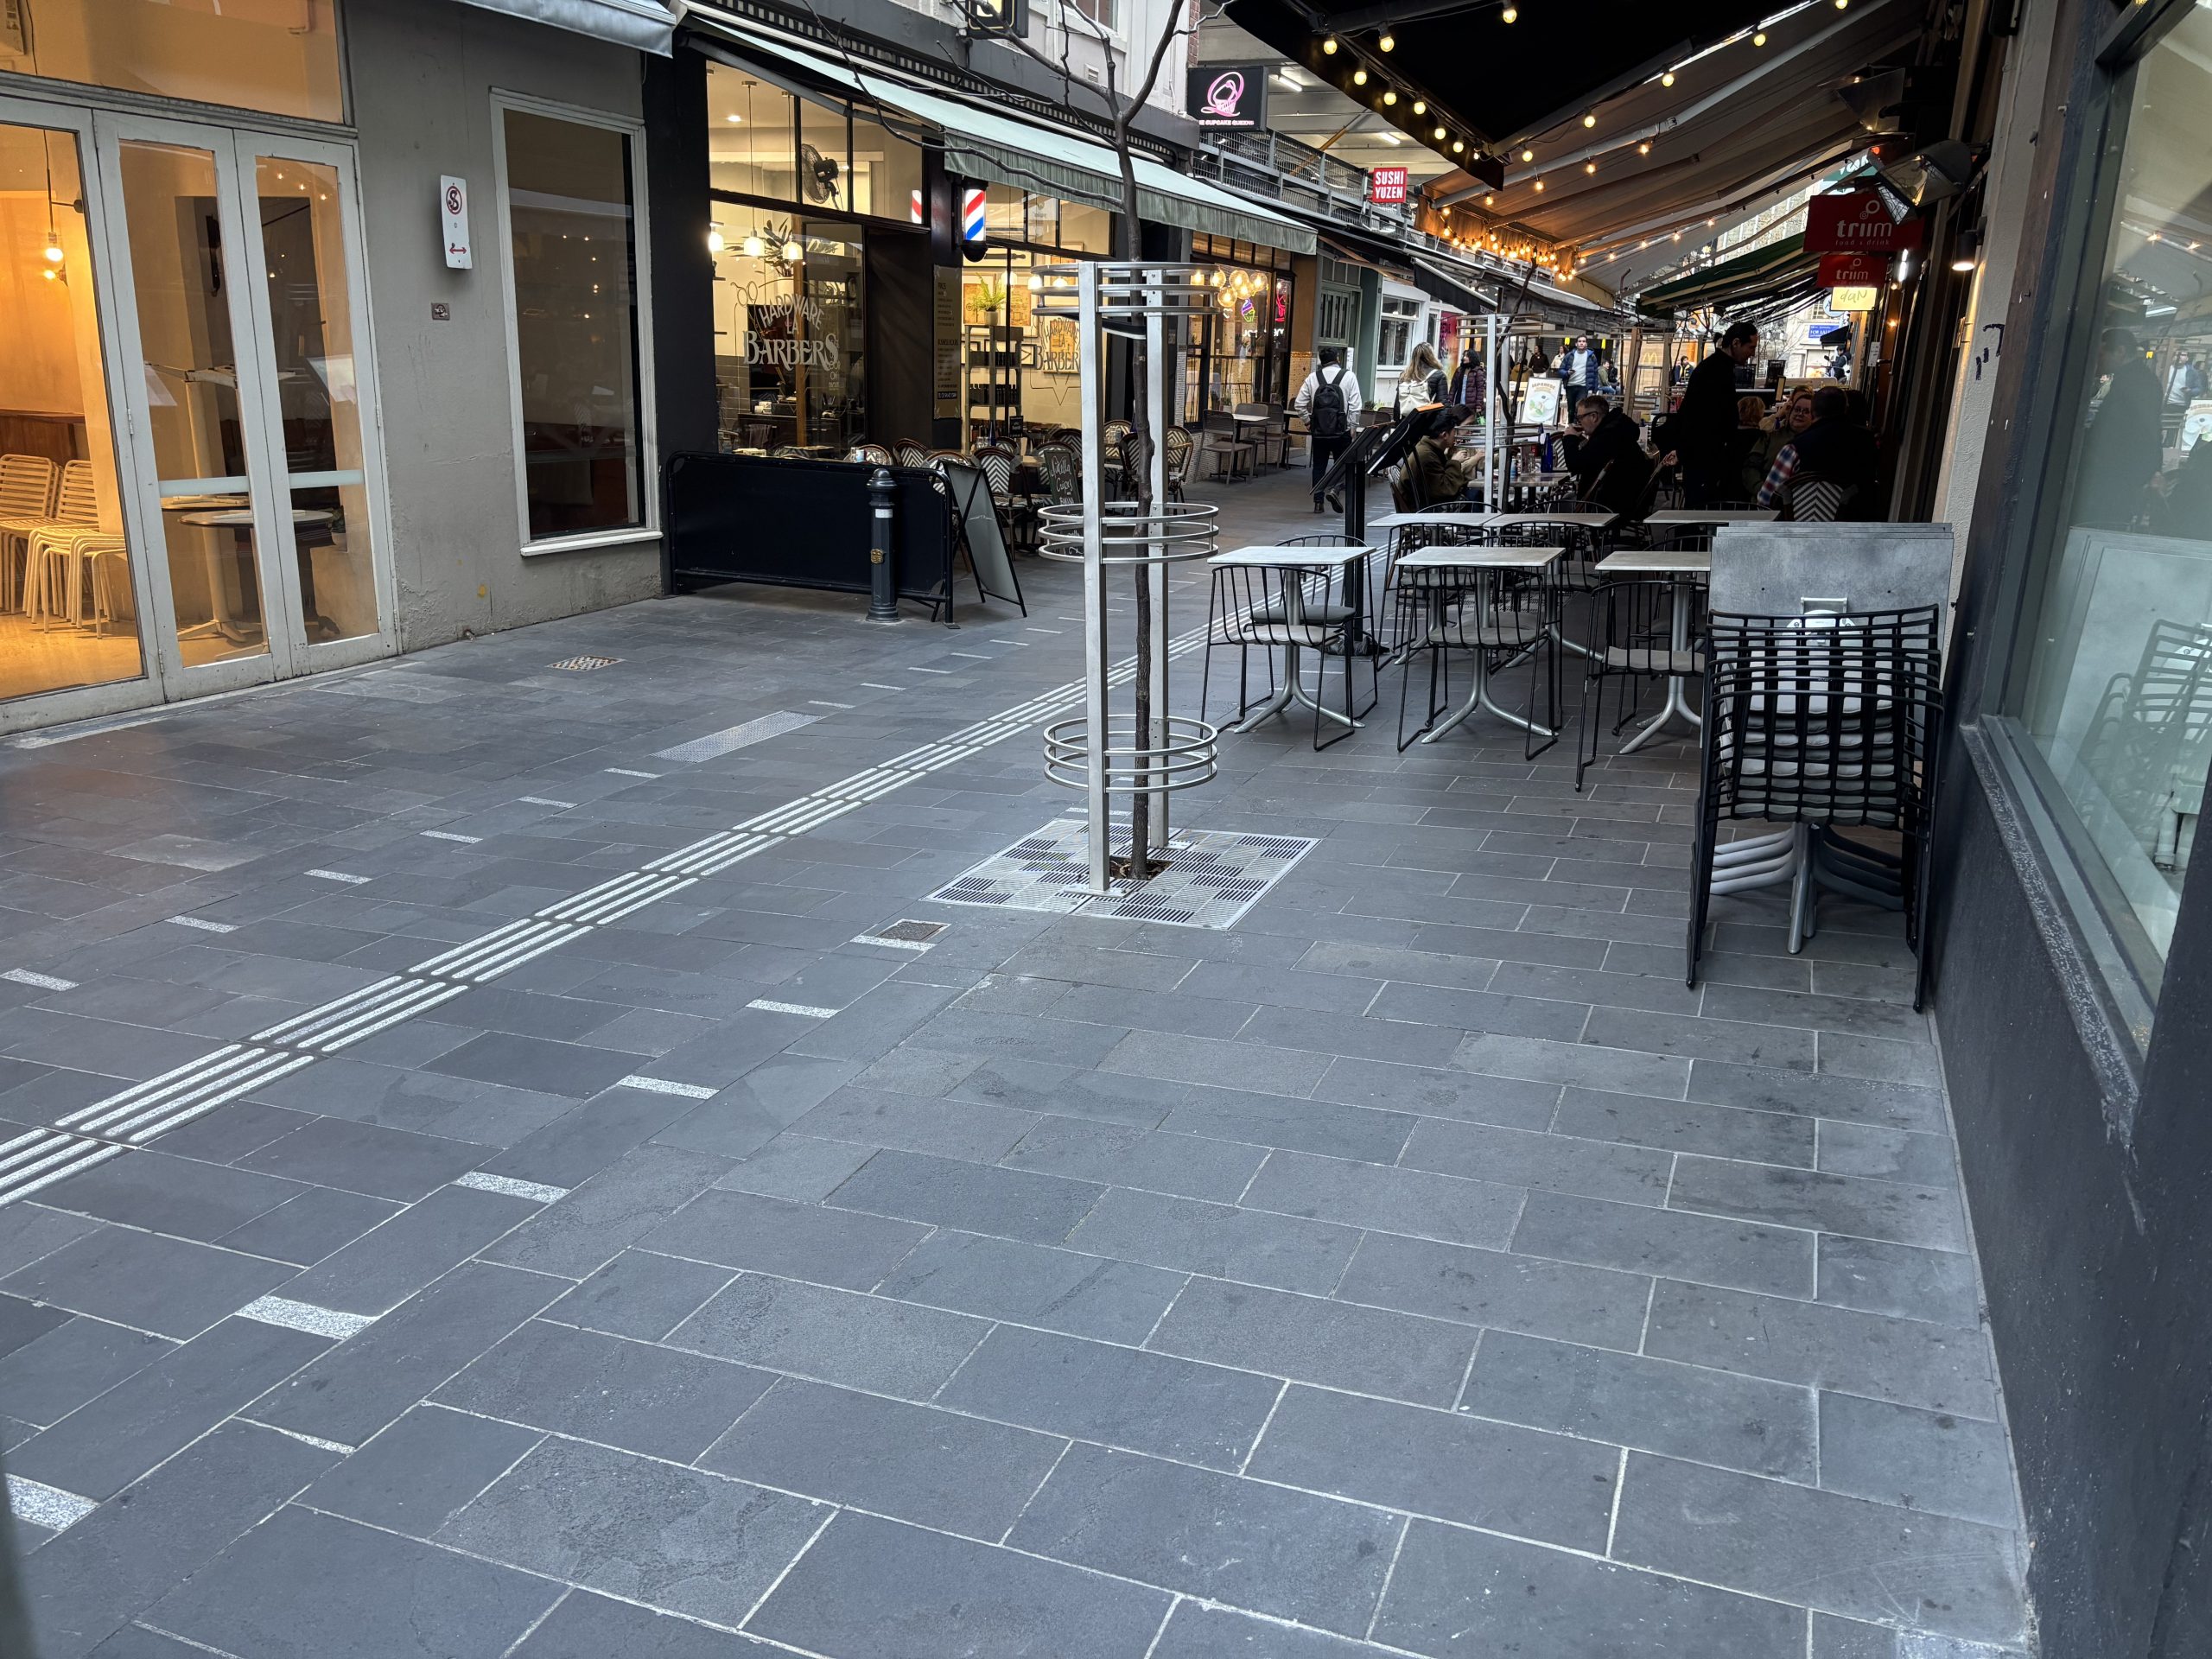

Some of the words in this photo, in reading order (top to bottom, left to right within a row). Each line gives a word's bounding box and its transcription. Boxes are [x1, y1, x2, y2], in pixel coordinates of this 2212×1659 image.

[1375, 170, 1404, 185] SUSHI
[1375, 186, 1403, 199] YUZEN
[759, 294, 824, 330] HARDWARE
[743, 330, 839, 372] BARBERS
[1036, 346, 1080, 374] BARBER
